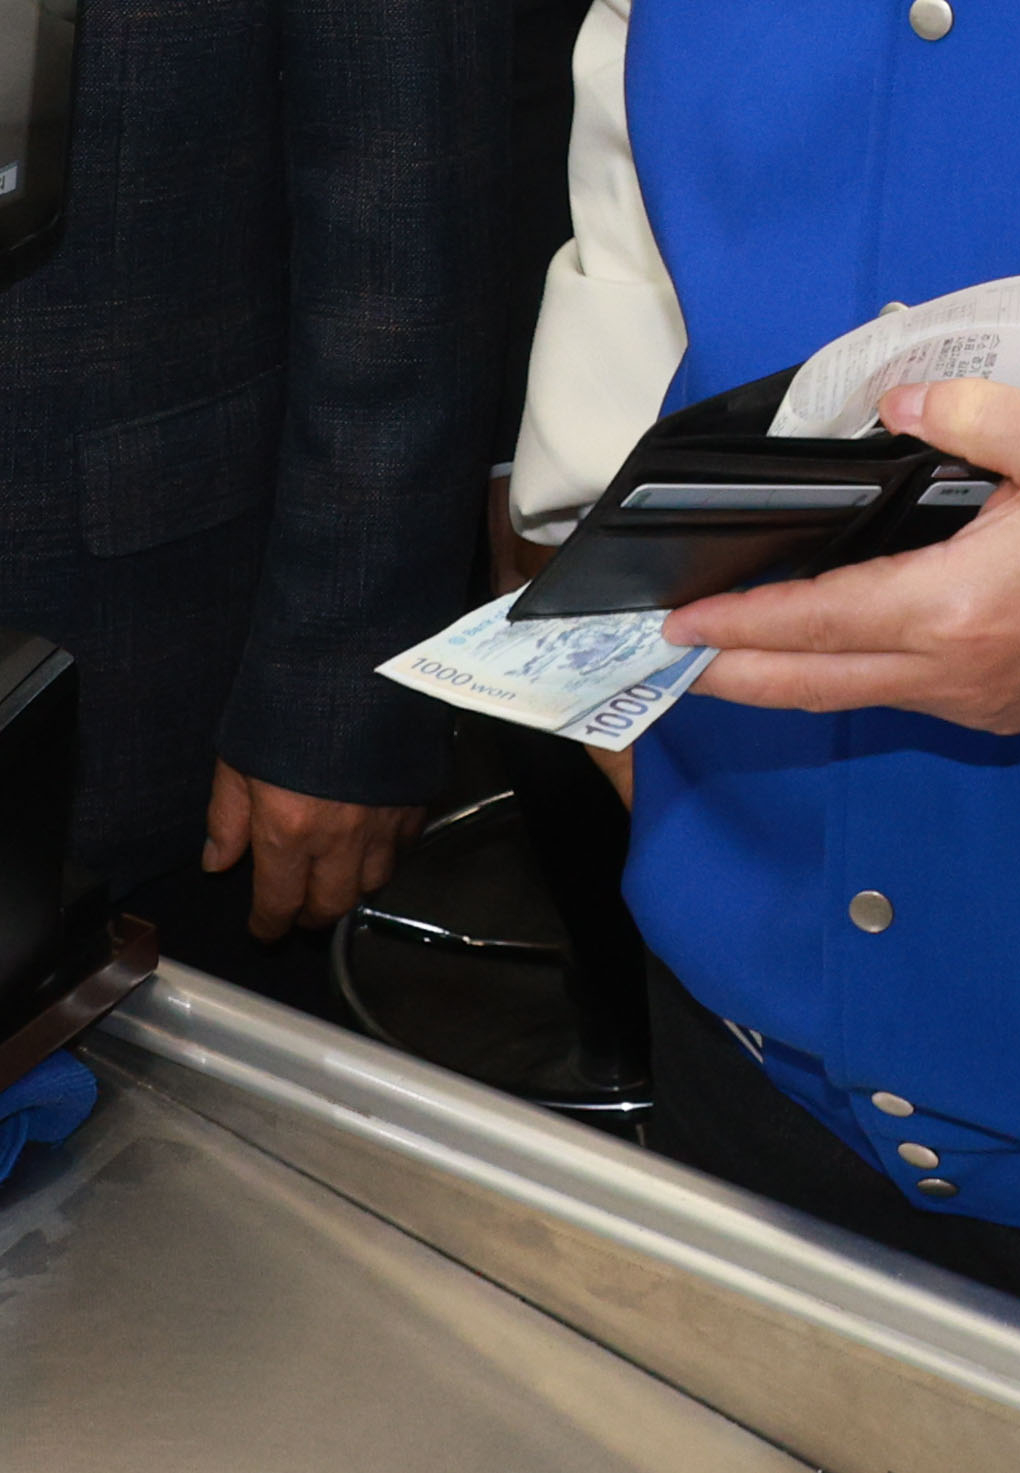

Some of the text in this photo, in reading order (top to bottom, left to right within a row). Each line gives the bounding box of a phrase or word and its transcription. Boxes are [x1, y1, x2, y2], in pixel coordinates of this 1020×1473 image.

[411, 657, 516, 701] 1000 won
[585, 684, 663, 738] 1000
